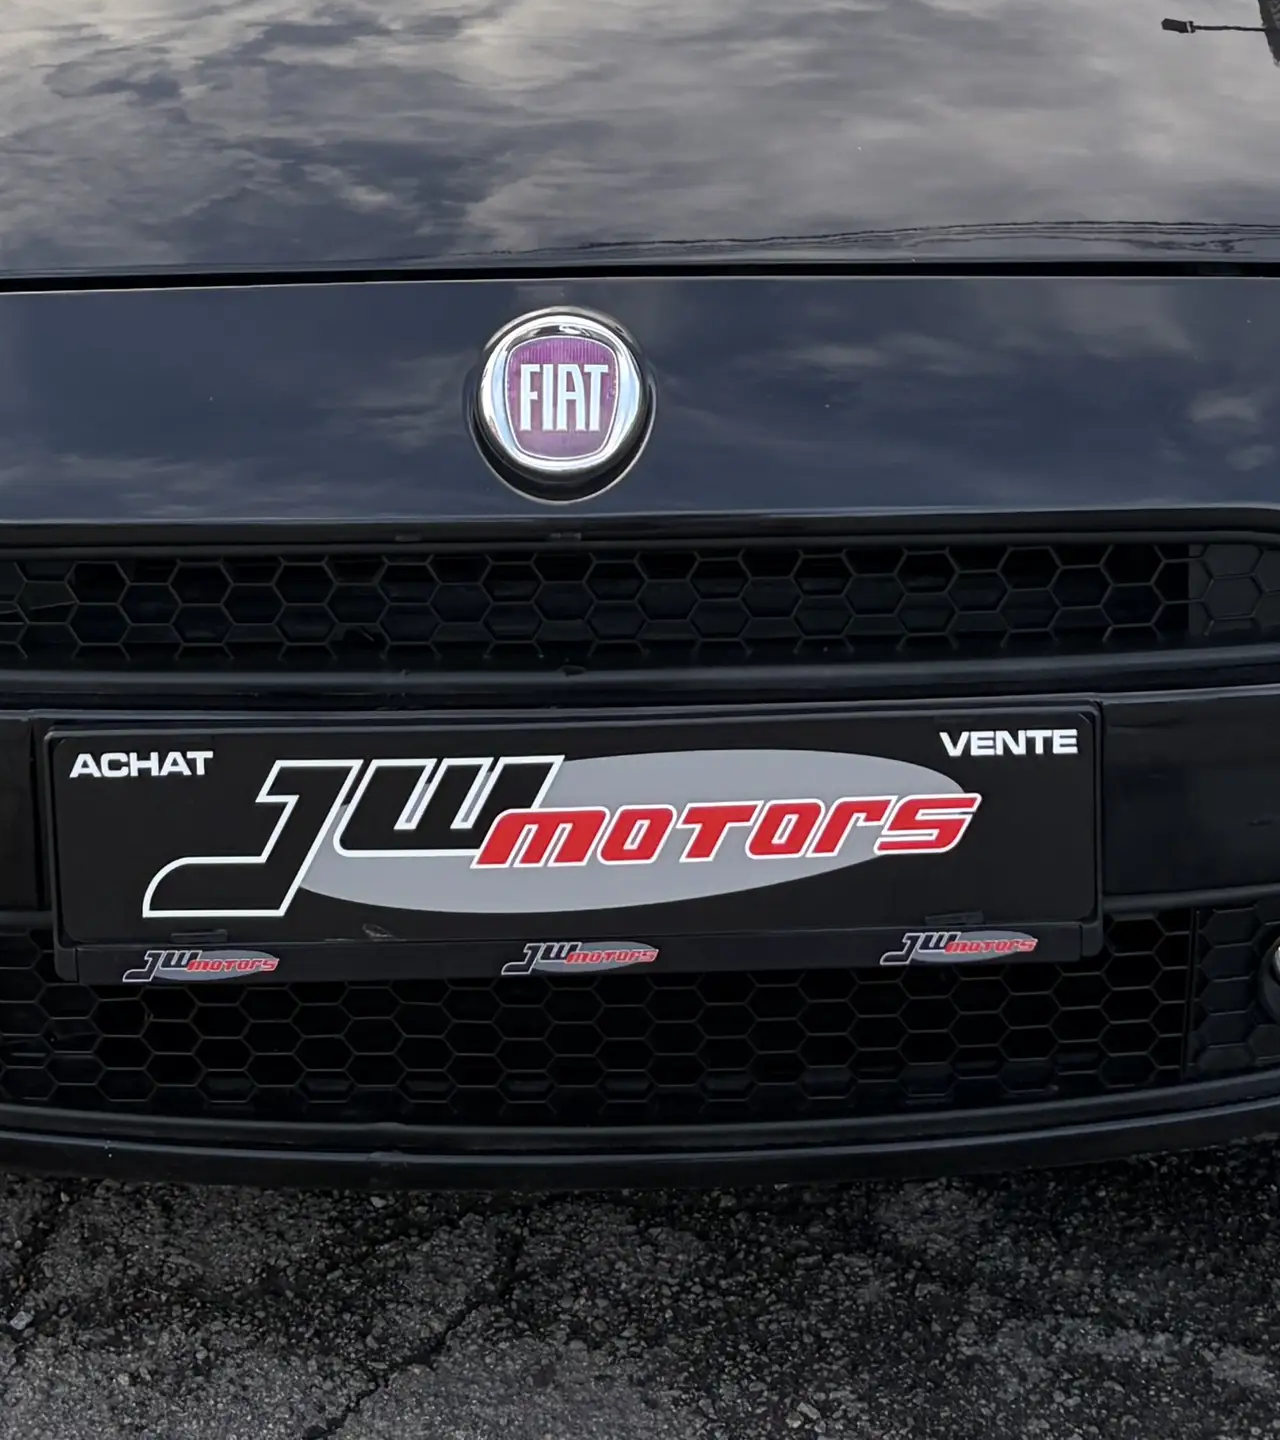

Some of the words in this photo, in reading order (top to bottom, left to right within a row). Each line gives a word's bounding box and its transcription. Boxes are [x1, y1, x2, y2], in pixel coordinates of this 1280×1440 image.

[520, 363, 609, 432] FIAT
[939, 728, 1078, 757] VENTE
[69, 750, 213, 778] ACHAT
[143, 755, 565, 917] JW
[501, 942, 582, 975] JW
[880, 932, 961, 965] JW
[122, 950, 203, 982] JW
